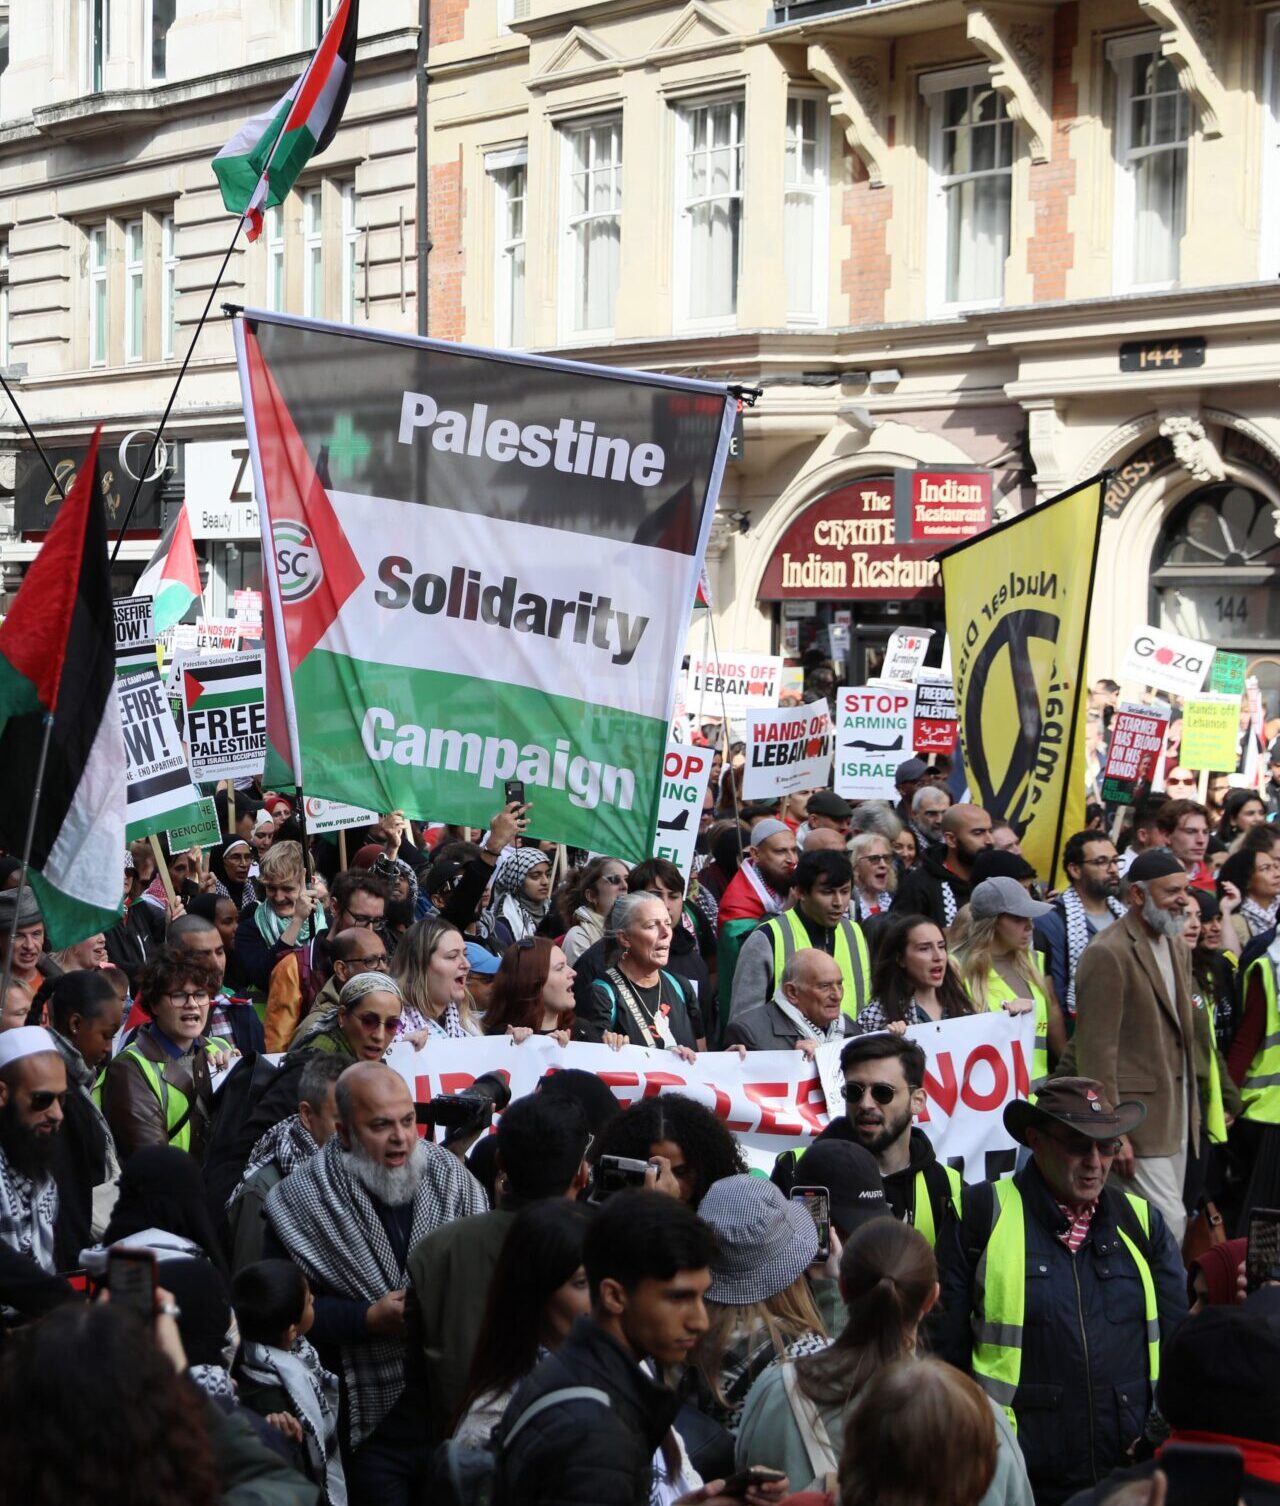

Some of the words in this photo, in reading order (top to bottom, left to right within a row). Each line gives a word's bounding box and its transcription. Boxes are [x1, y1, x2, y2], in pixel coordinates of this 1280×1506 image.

[1140, 347, 1182, 368] 144
[397, 390, 666, 488] Palestine
[920, 479, 982, 503] Indian
[860, 492, 891, 511] The
[202, 510, 232, 533] Beauty
[915, 505, 986, 522] Restaurant
[782, 553, 847, 588] Indian
[852, 552, 942, 588] Restaur
[373, 554, 651, 667] Solidarity
[1215, 597, 1248, 622] 144
[115, 618, 149, 644] OW!
[224, 625, 238, 636] OFF
[182, 658, 208, 668] Palestine
[208, 655, 234, 665] Solidarity
[235, 653, 262, 663] Campaign
[891, 652, 920, 666] Arming
[1134, 637, 1203, 674] Gza
[128, 670, 155, 685] CAMPAIGN
[695, 660, 746, 679] HANDS
[751, 665, 777, 680] OFF
[889, 667, 914, 680] Israel
[845, 694, 909, 714] STOP
[1189, 703, 1217, 715] Hands
[1221, 704, 1235, 716] off
[187, 703, 265, 743] FREE
[753, 719, 806, 743] HANDS
[809, 713, 830, 736] OFF
[843, 715, 907, 730] ARMING
[1117, 715, 1158, 733] STARMER
[191, 733, 266, 758] PALESTINE
[1115, 731, 1133, 747] HAS
[1133, 734, 1161, 752] BLOOD
[193, 758, 206, 767] END
[207, 755, 231, 765] ISRAELI
[361, 707, 637, 812] Campaign
[1111, 746, 1126, 760] ON
[1125, 748, 1141, 763] HIS
[138, 765, 151, 778] END
[152, 756, 184, 774] APARTHEID
[663, 752, 704, 780] OP
[840, 762, 896, 778] ISRAE
[1108, 760, 1138, 778] HANDS
[662, 781, 698, 804] ING
[171, 820, 217, 839] GENOCIDE
[858, 1189, 884, 1200] MUSTO
